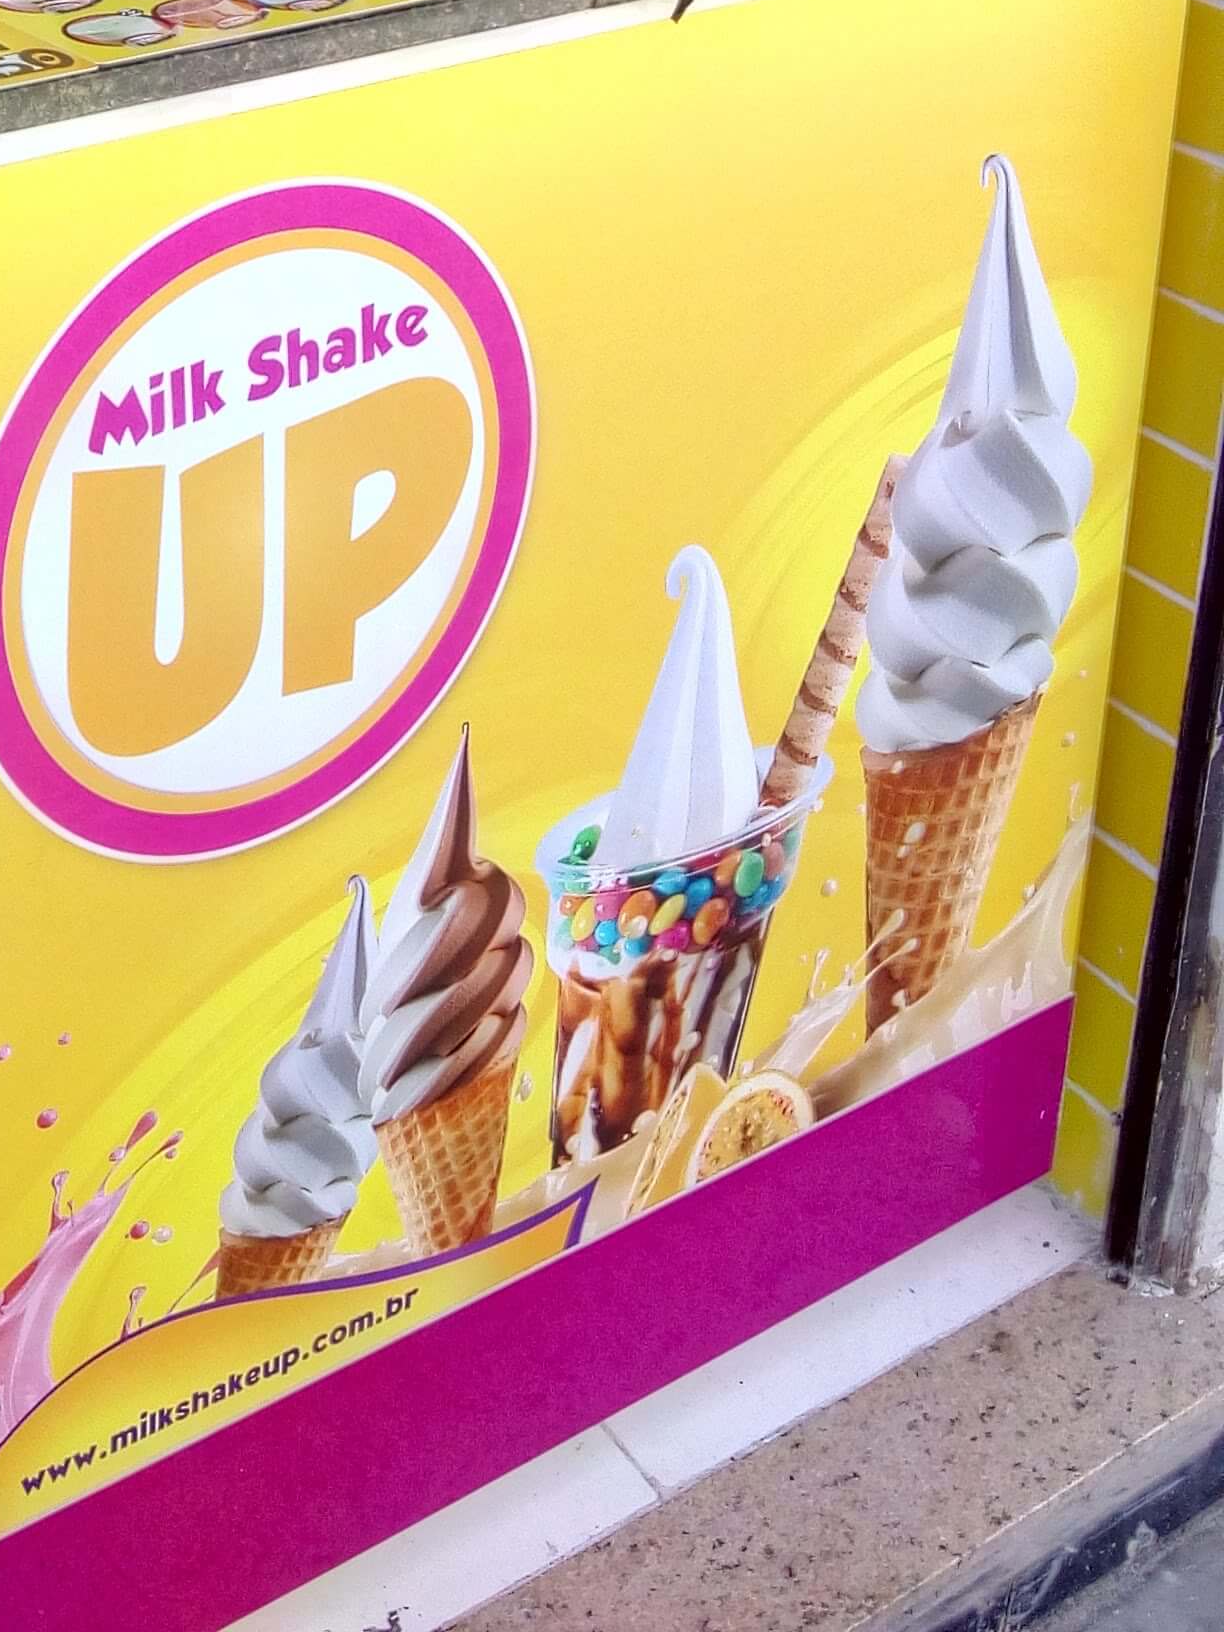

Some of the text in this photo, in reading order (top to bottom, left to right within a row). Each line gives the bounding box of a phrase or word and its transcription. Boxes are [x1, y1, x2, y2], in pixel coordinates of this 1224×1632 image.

[87, 302, 429, 455] Milk Shake
[67, 375, 474, 758] UP
[20, 1286, 419, 1496] www.milkshakeup.com.br
